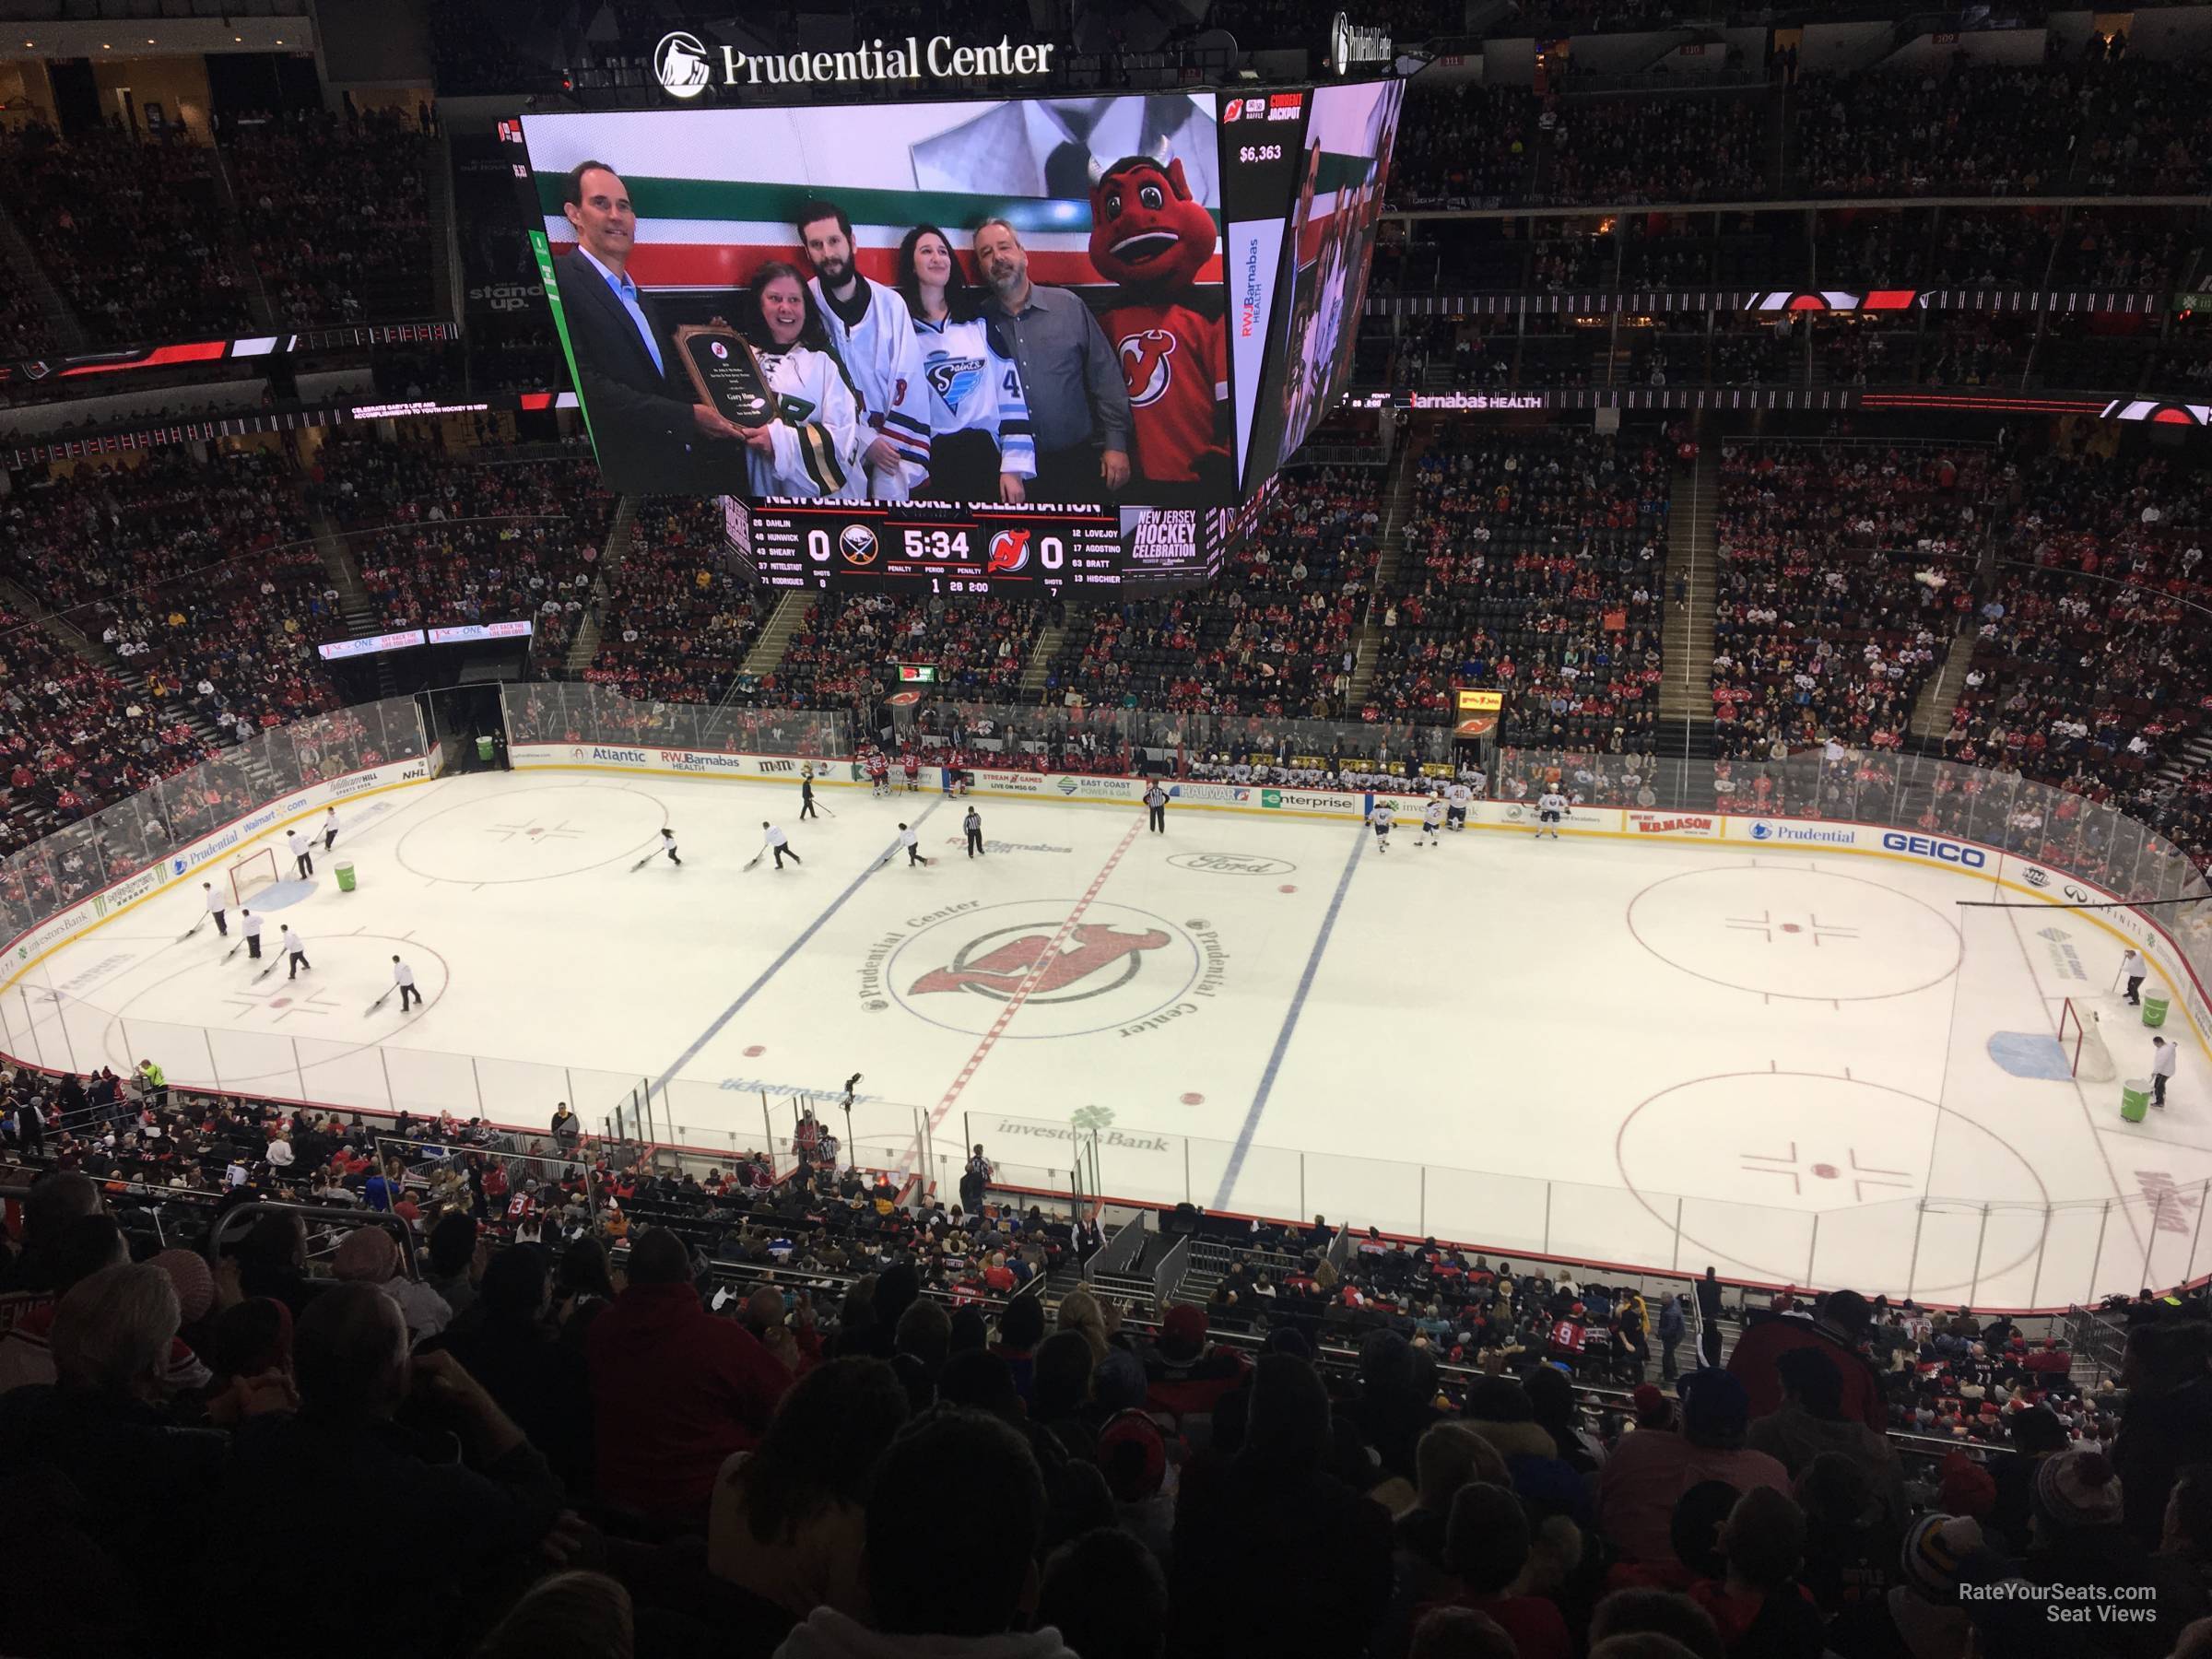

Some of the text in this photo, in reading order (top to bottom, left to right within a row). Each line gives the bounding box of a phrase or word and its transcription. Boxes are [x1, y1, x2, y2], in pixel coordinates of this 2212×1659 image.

[722, 34, 1055, 85] Prudential Center
[1269, 93, 1303, 107] CURRENT
[1267, 107, 1301, 121] JACKPOT
[1240, 145, 1281, 162] $6,363
[469, 283, 545, 300] stand
[1241, 239, 1258, 337] RWJBarnabas
[1253, 284, 1262, 323] HEALTH
[1489, 397, 1542, 408] HEALTH
[766, 519, 791, 528] DAHLIN
[1138, 510, 1196, 524] NEW JERSEY
[767, 534, 799, 542] HUNWICK
[1072, 529, 1118, 538] 12 LOVEJOY
[1135, 524, 1196, 545] HOCKEY
[807, 529, 830, 561] 0
[904, 530, 970, 559] 5:34
[1073, 544, 1121, 553] 17 AGOSTINO
[1132, 544, 1196, 558] CELEBRATION
[769, 548, 795, 557] SHEARY
[1040, 536, 1064, 570] 0
[888, 565, 912, 573] PENALTY
[1086, 559, 1110, 569] BRATT
[1074, 574, 1121, 583] 13 HISCHIER
[933, 579, 940, 593] 1
[969, 582, 988, 593] 2:00
[1051, 588, 1057, 597] 7
[463, 627, 482, 635] ONE
[354, 638, 375, 649] ONE
[592, 747, 646, 763] Atlantic
[661, 751, 740, 767] RWJBarnabas
[672, 761, 706, 771] HEALTH
[402, 770, 427, 781] NHL
[1019, 775, 1043, 783] GAMES
[335, 785, 356, 796] SPORTS
[1080, 779, 1131, 789] EAST COAST
[1080, 788, 1106, 796] POWER
[1116, 789, 1132, 797] GAS
[1180, 784, 1236, 801] HALMAR
[1453, 789, 1465, 799] 40
[1267, 794, 1353, 808] enterprise
[242, 798, 307, 833] Walmart com
[1778, 826, 1855, 843] Prudential
[190, 830, 238, 865] Prudential
[1883, 832, 1985, 869] GEICO
[1197, 853, 1274, 874] Ford
[2022, 868, 2052, 887] NHL
[29, 912, 89, 953] investorsBank
[856, 900, 980, 999] Prudential Center
[1118, 931, 1231, 1038] Prudential Center
